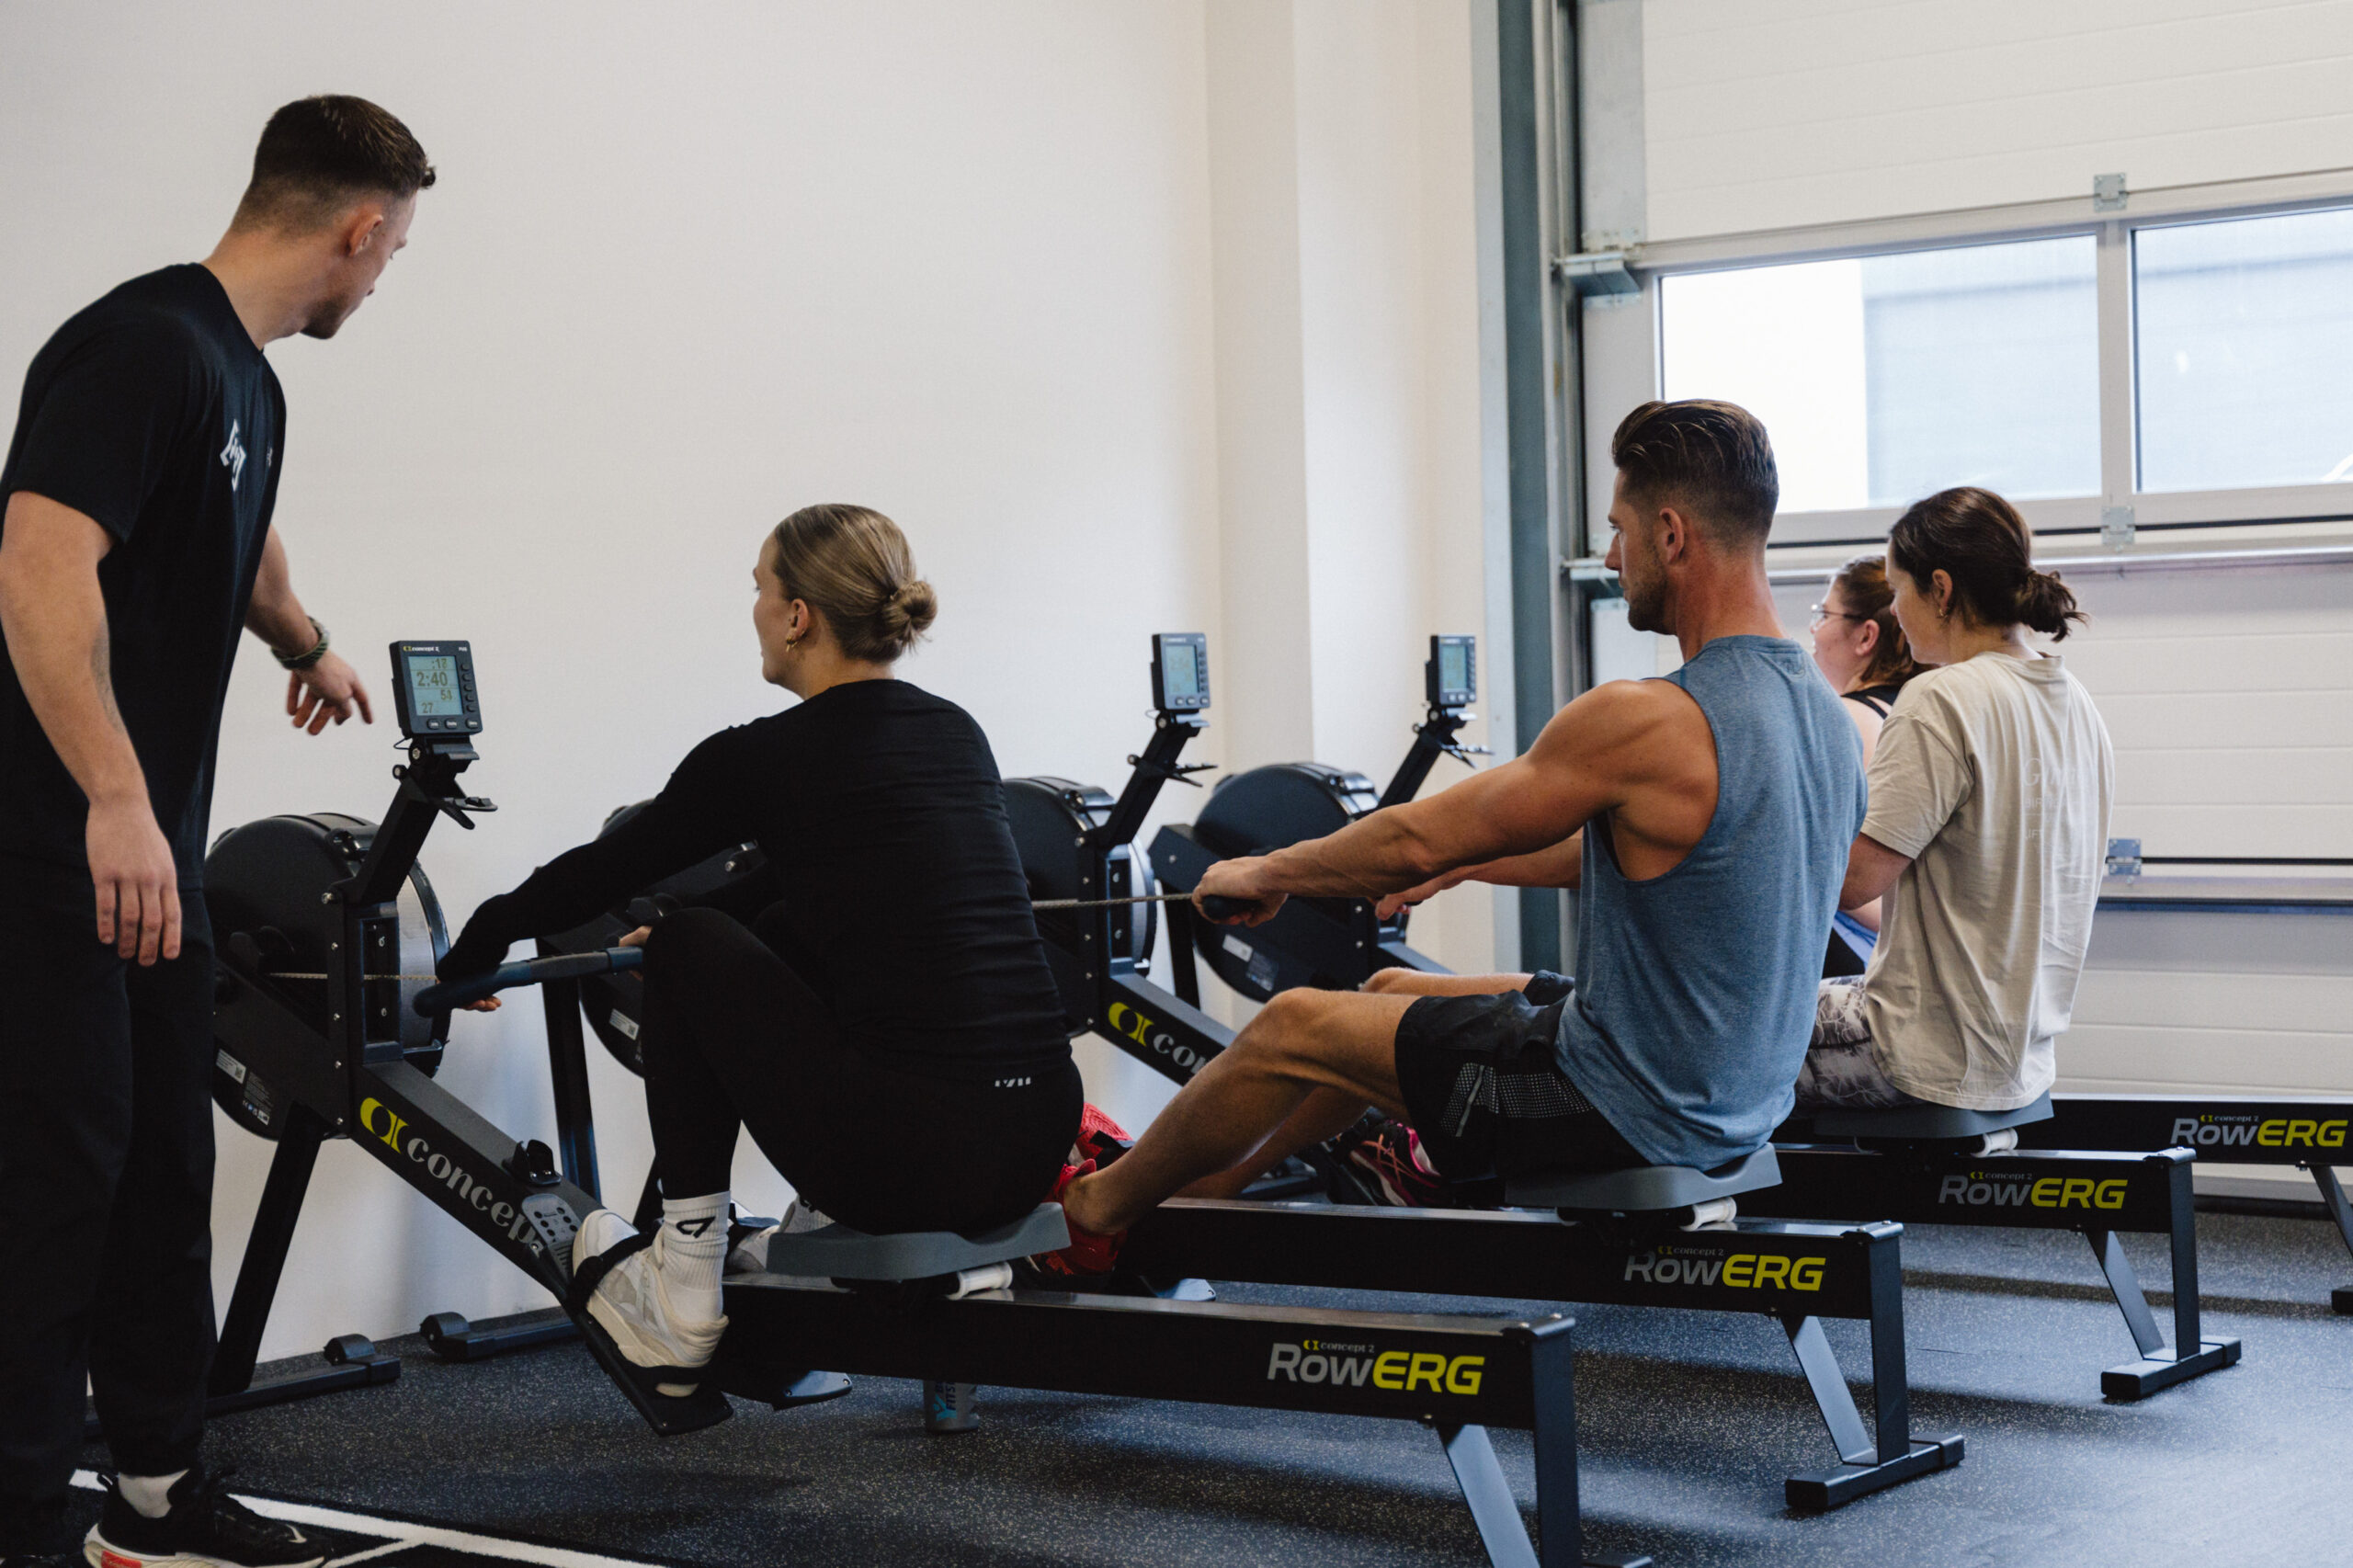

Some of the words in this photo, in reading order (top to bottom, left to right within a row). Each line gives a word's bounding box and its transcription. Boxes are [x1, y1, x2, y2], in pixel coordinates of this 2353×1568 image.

[416, 671, 448, 687] 2:40
[422, 702, 434, 714] 27
[1320, 1342, 1366, 1353] concept
